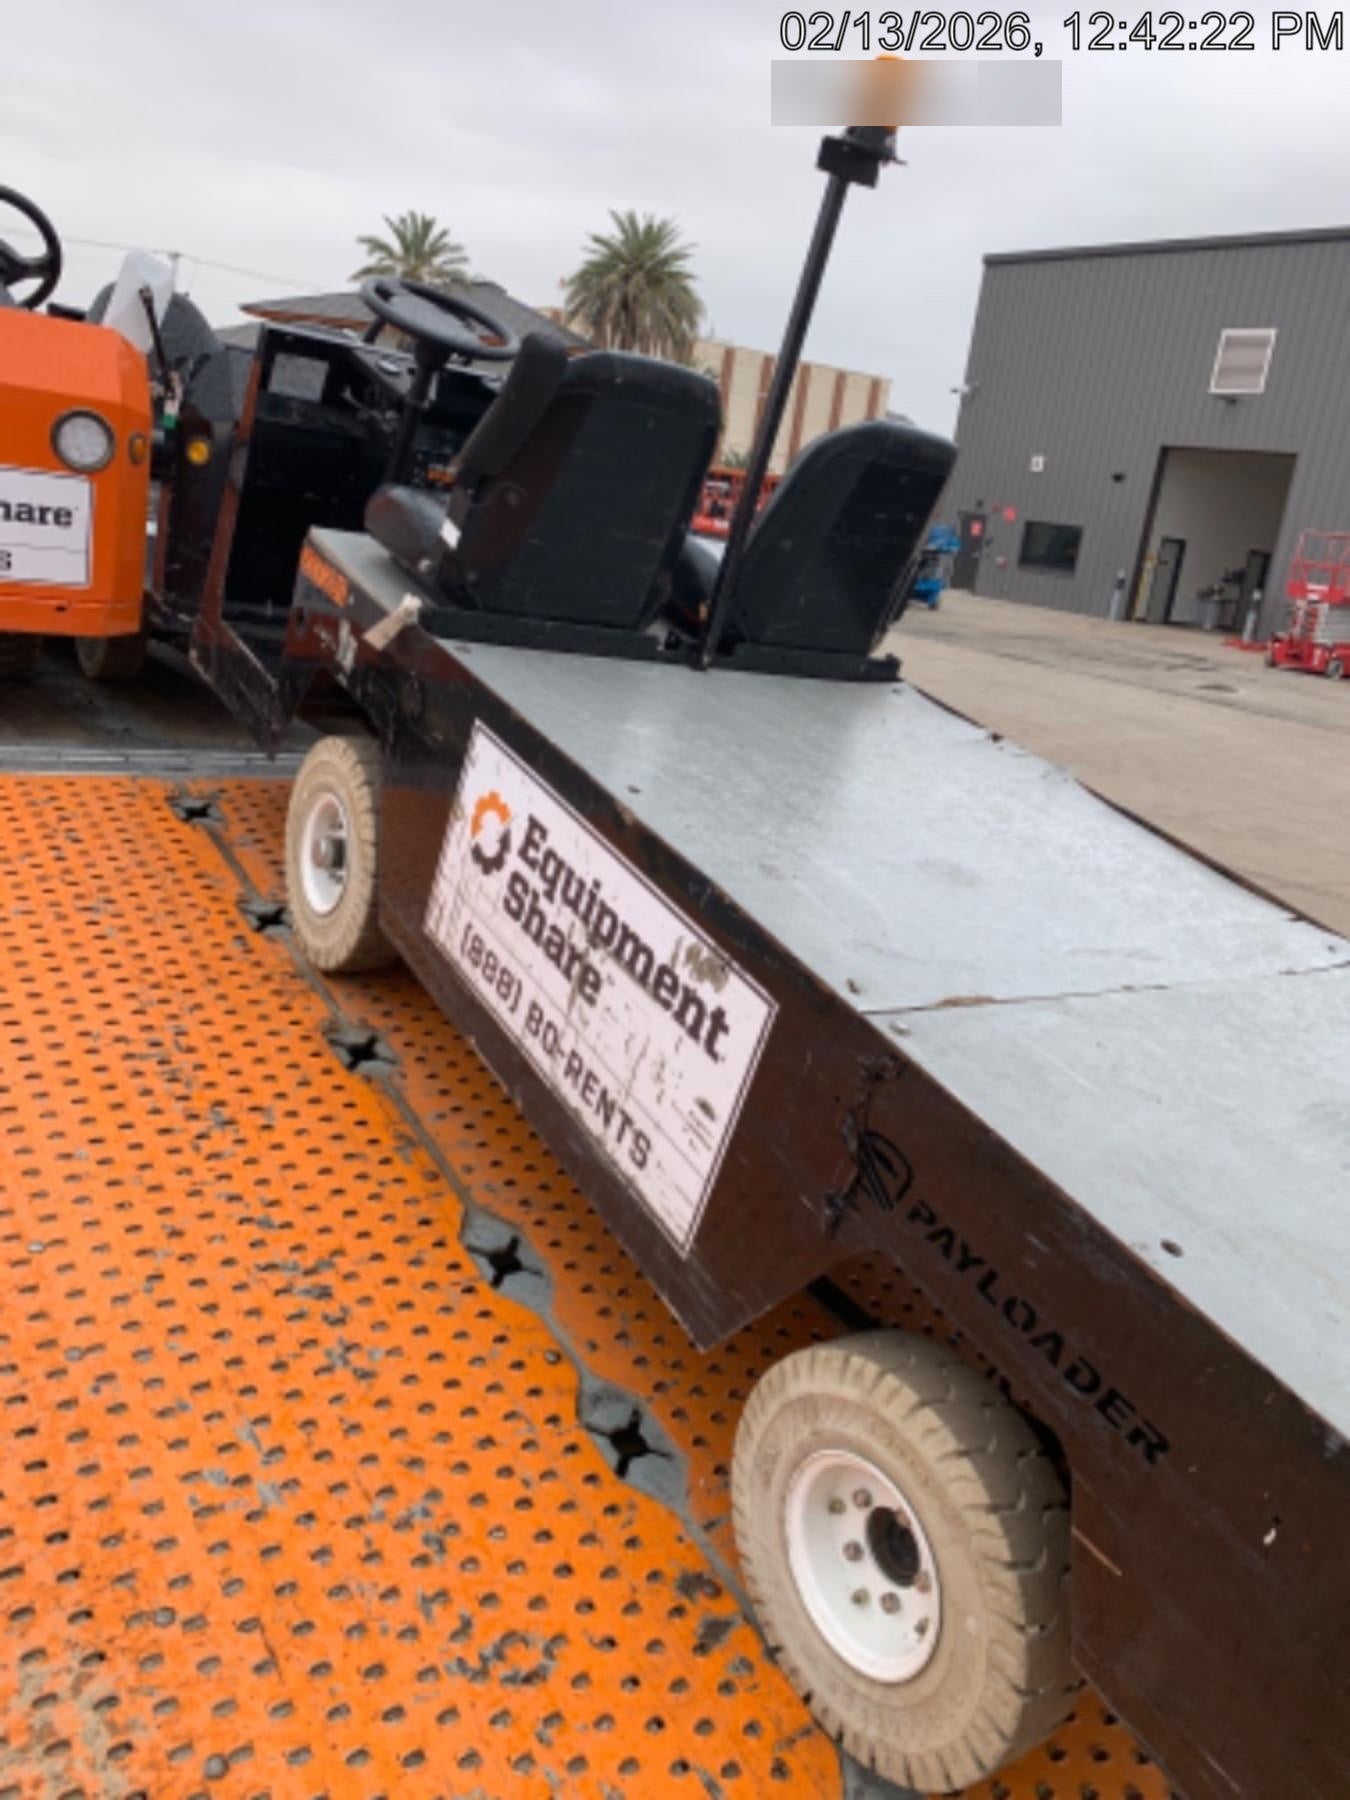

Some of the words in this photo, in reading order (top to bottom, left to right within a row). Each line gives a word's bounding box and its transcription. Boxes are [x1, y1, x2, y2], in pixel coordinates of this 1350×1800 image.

[460, 923, 524, 1012] (888)
[502, 873, 601, 1009] Share
[516, 814, 731, 1063] Equipment
[907, 1200, 1170, 1464] PAYLOADER
